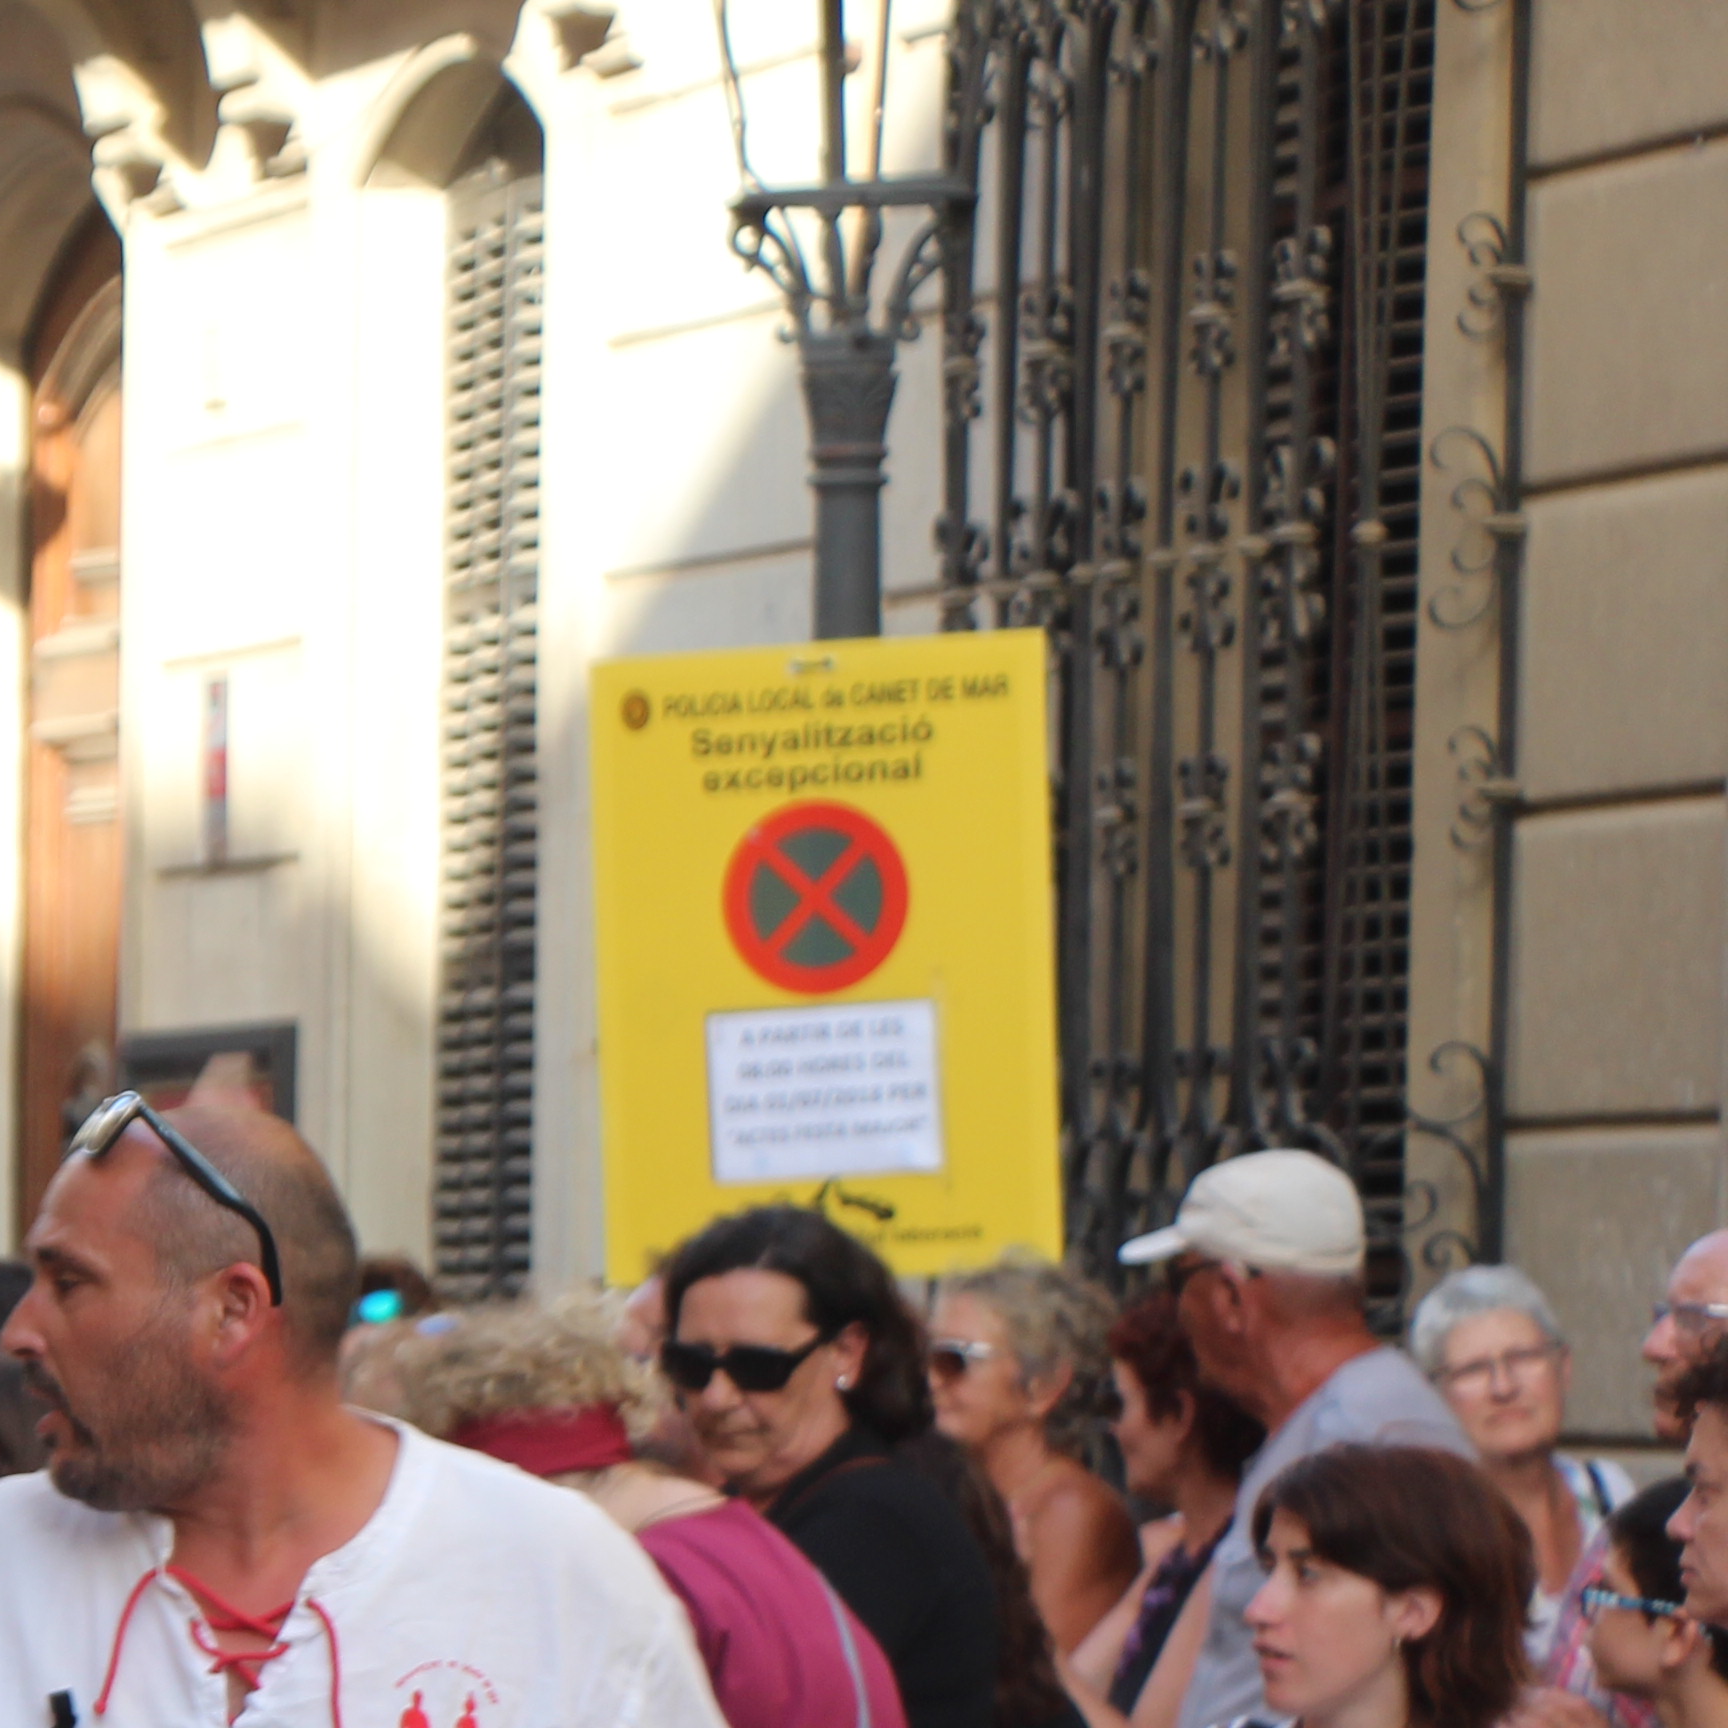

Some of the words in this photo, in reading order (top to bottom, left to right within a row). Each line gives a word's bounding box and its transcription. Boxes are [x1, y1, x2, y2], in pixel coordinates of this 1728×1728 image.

[749, 688, 812, 713] LOCAL
[962, 673, 1009, 698] MAR
[692, 714, 933, 758] Senyalització
[702, 751, 922, 793] excepcional
